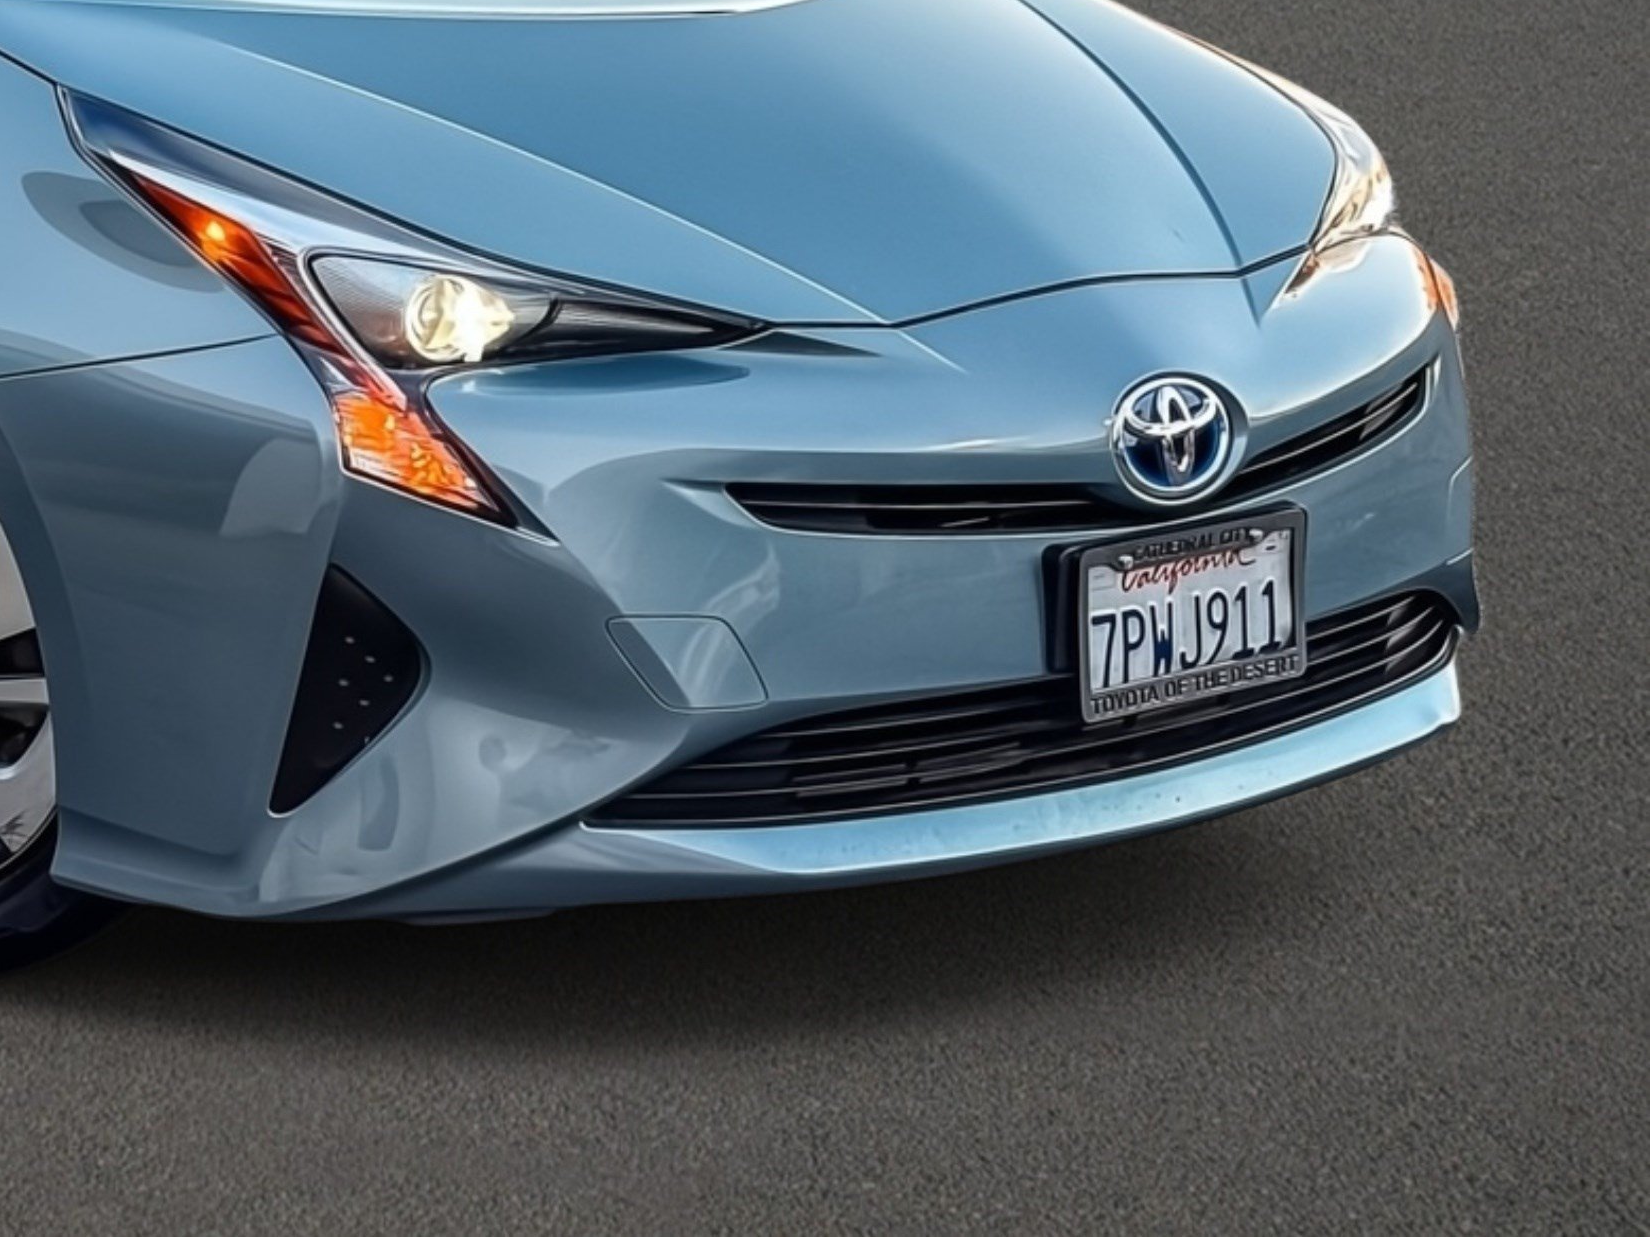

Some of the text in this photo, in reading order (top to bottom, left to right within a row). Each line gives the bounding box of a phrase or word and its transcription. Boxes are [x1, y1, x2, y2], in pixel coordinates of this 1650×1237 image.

[1091, 579, 1281, 688] 7PWJ911
[1091, 655, 1299, 714] TOYOTA OF THE DESERT
